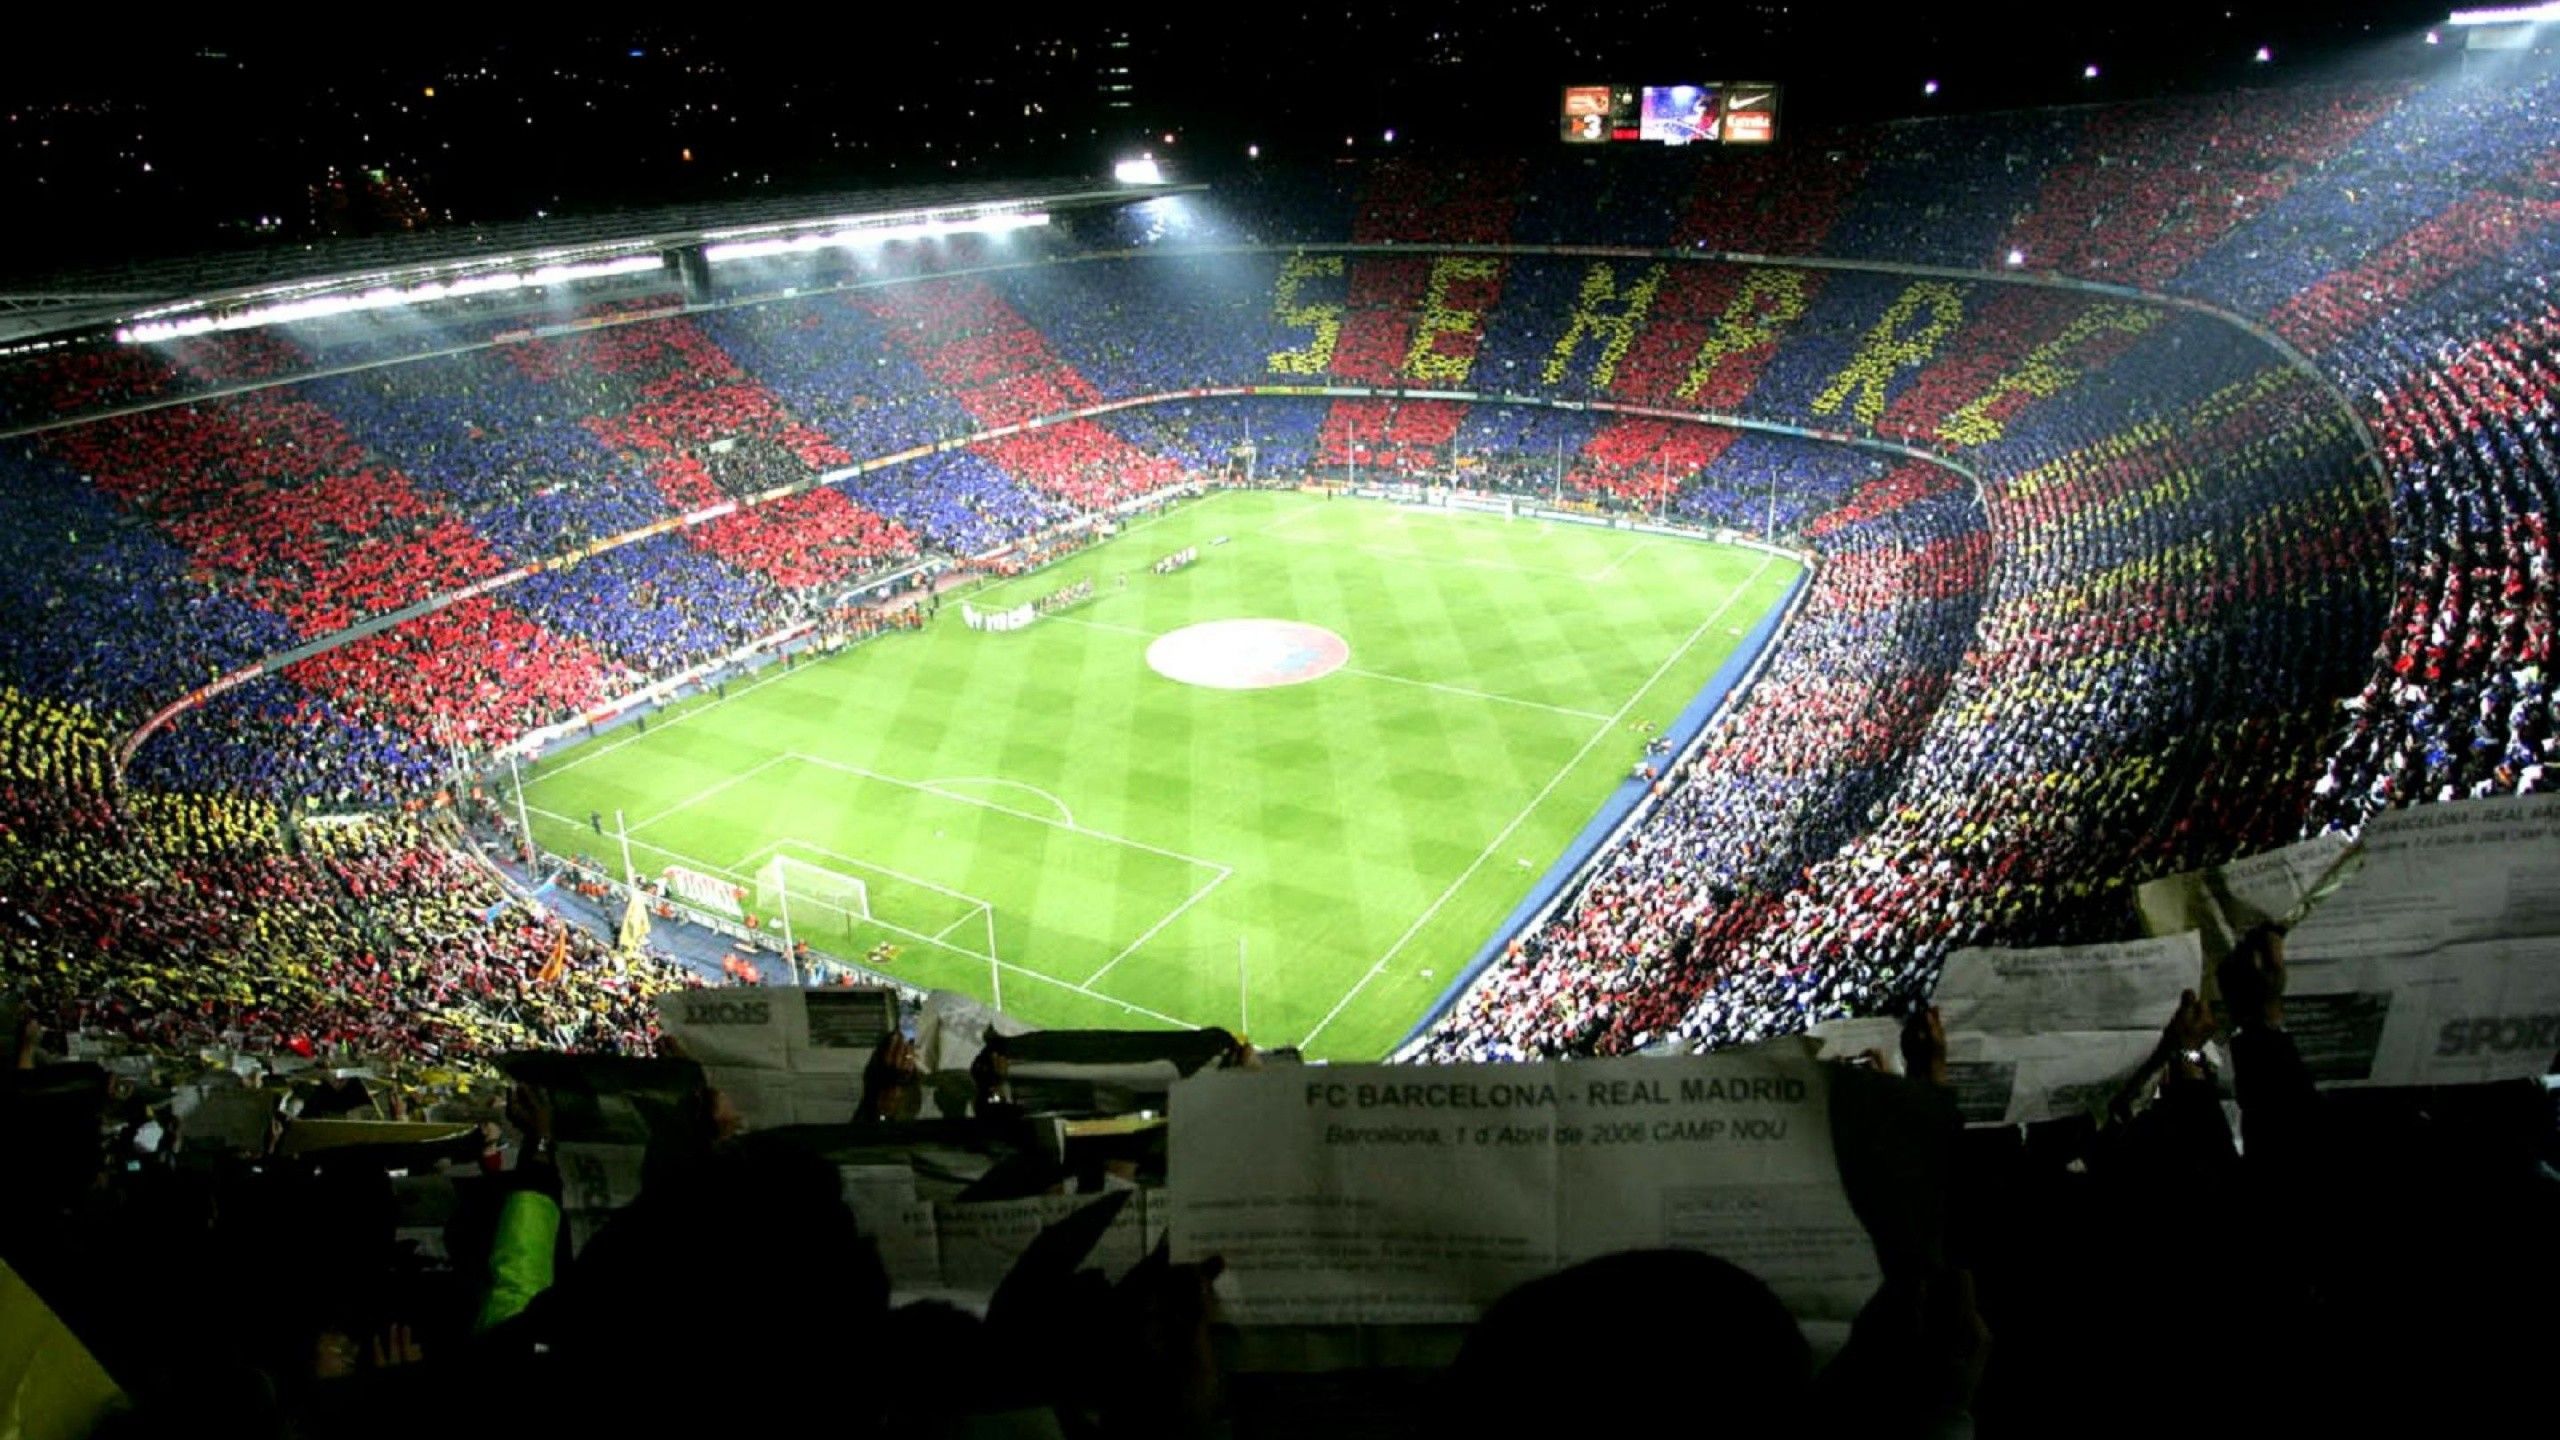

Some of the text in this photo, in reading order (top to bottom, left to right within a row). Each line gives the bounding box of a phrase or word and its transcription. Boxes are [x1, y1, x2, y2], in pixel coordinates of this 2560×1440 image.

[1583, 114, 1601, 139] 3
[1305, 1083, 1347, 1109] FC
[1357, 1082, 1556, 1109] BARCELONA
[1587, 1079, 1670, 1108] REAL
[1680, 1077, 1805, 1104] MADRID
[1652, 1120, 1726, 1143] CAMP
[1731, 1119, 1787, 1141] NOU
